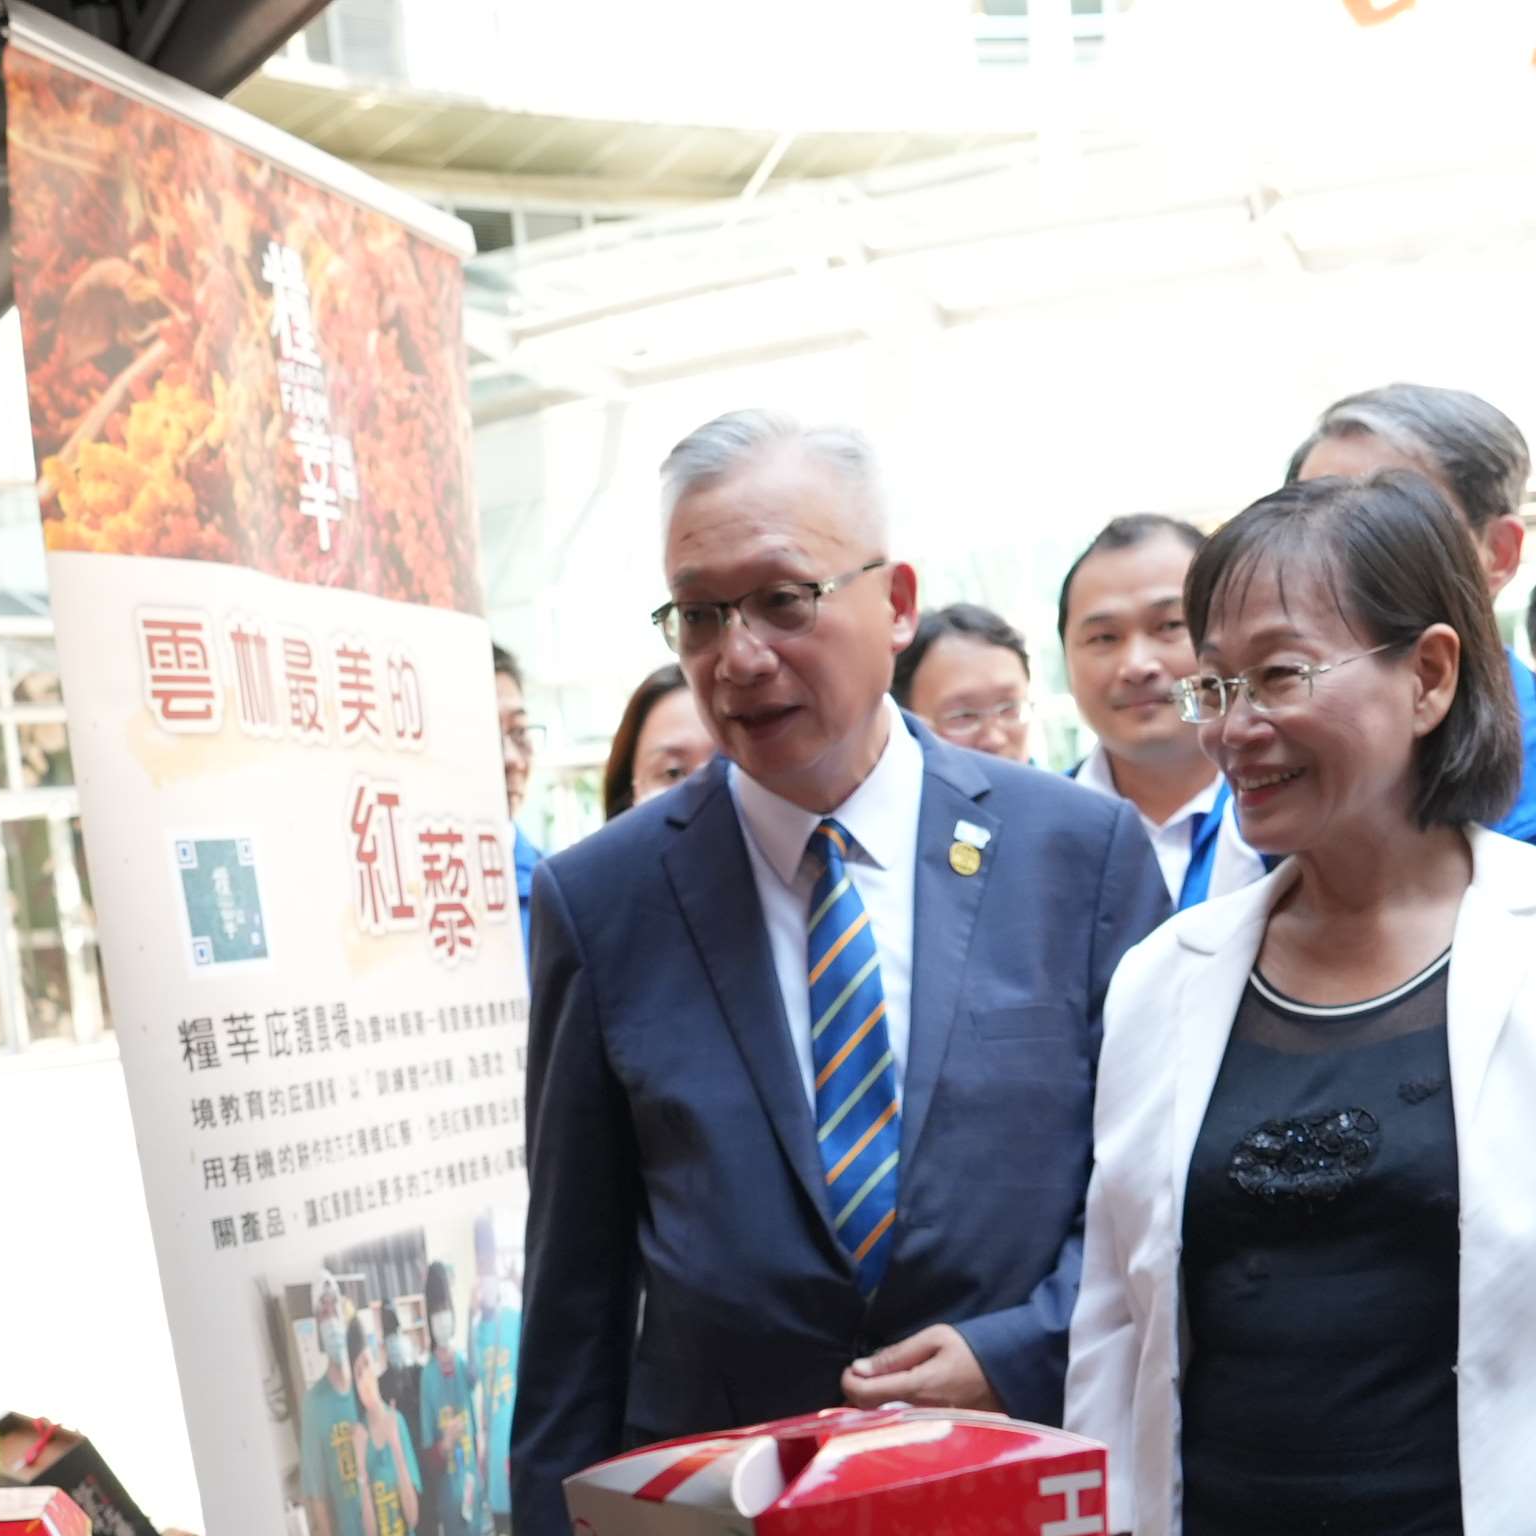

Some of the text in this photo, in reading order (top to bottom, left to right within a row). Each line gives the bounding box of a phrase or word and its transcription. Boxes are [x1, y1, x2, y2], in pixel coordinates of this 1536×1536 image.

[142, 618, 424, 740] 雲林最美的
